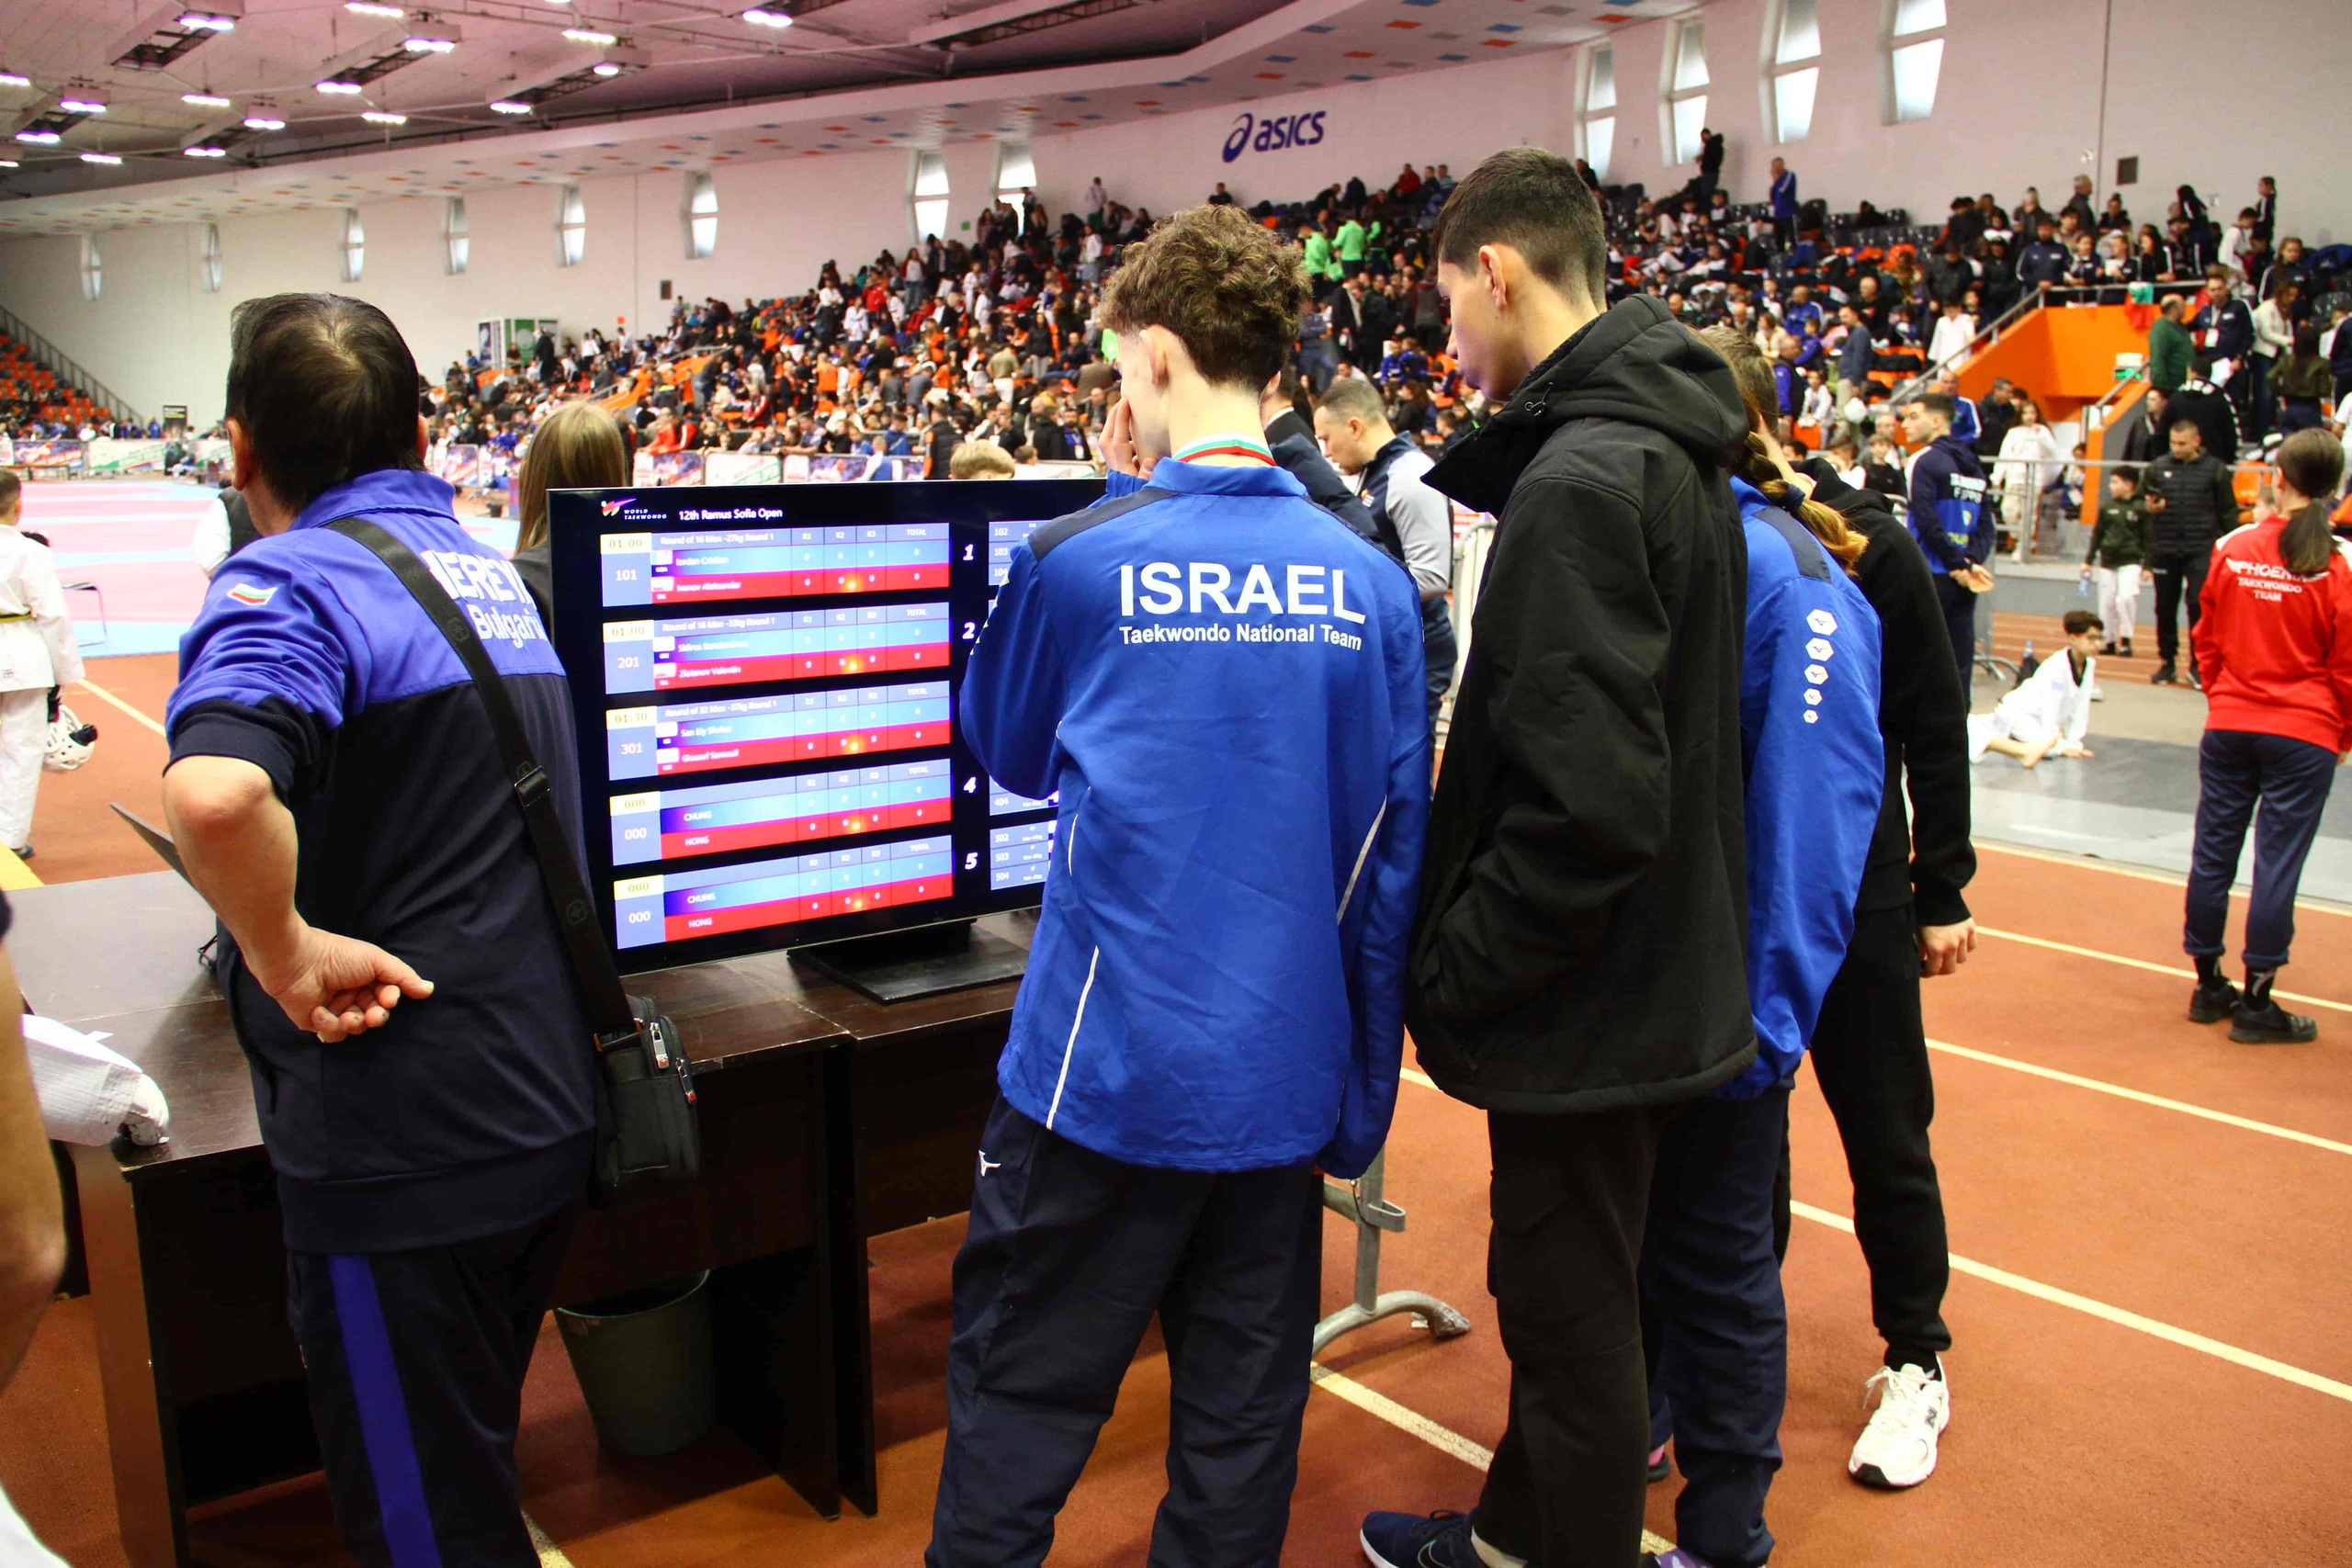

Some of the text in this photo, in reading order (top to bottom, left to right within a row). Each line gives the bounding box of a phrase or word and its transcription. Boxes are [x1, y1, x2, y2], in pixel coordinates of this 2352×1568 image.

[1253, 110, 1327, 152] asics
[679, 508, 783, 521] 12th Ramus Sofia Open
[994, 527, 1008, 536] 102
[609, 539, 642, 548] 01:00
[661, 536, 687, 545] Round
[687, 536, 695, 544] of
[695, 535, 705, 544] 16
[706, 535, 722, 543] Men
[745, 533, 769, 542] Round
[963, 544, 974, 561] 1
[994, 547, 1008, 557] 103
[616, 570, 638, 581] 101
[2237, 577, 2303, 593] TAEKWONDO
[1121, 562, 1366, 625] ISRAEL
[2254, 590, 2282, 602] TEAM
[467, 604, 548, 649] Bulgari
[662, 623, 686, 632] Round
[687, 622, 695, 630] of
[697, 622, 707, 630] 16
[707, 621, 724, 629] Men
[746, 618, 770, 626] Round
[962, 622, 976, 639] 2
[612, 627, 644, 637] 01:00
[1119, 623, 1362, 650] Taekwondo National Team
[617, 657, 639, 668] 201
[711, 666, 741, 675] Valentin
[665, 708, 689, 717] Round
[690, 707, 697, 716] of
[699, 706, 708, 715] 32
[709, 705, 726, 714] Men
[749, 701, 772, 710] Round
[615, 714, 647, 724] 01:30
[621, 742, 643, 754] 301
[909, 766, 929, 774] TOTAL
[963, 776, 977, 794] 4
[625, 799, 645, 808] 000
[994, 797, 1009, 807] 404
[684, 811, 712, 821] CHUNG
[625, 828, 647, 840] 000
[995, 833, 1009, 842] 502
[685, 836, 709, 846] HONG
[910, 843, 930, 852] TOTAL
[965, 852, 978, 870] 5
[995, 852, 1010, 862] 503
[995, 872, 1010, 881] 504
[628, 883, 649, 892] 000
[687, 893, 716, 904] CHUNG
[628, 911, 650, 923] 000
[688, 918, 712, 928] HONG
